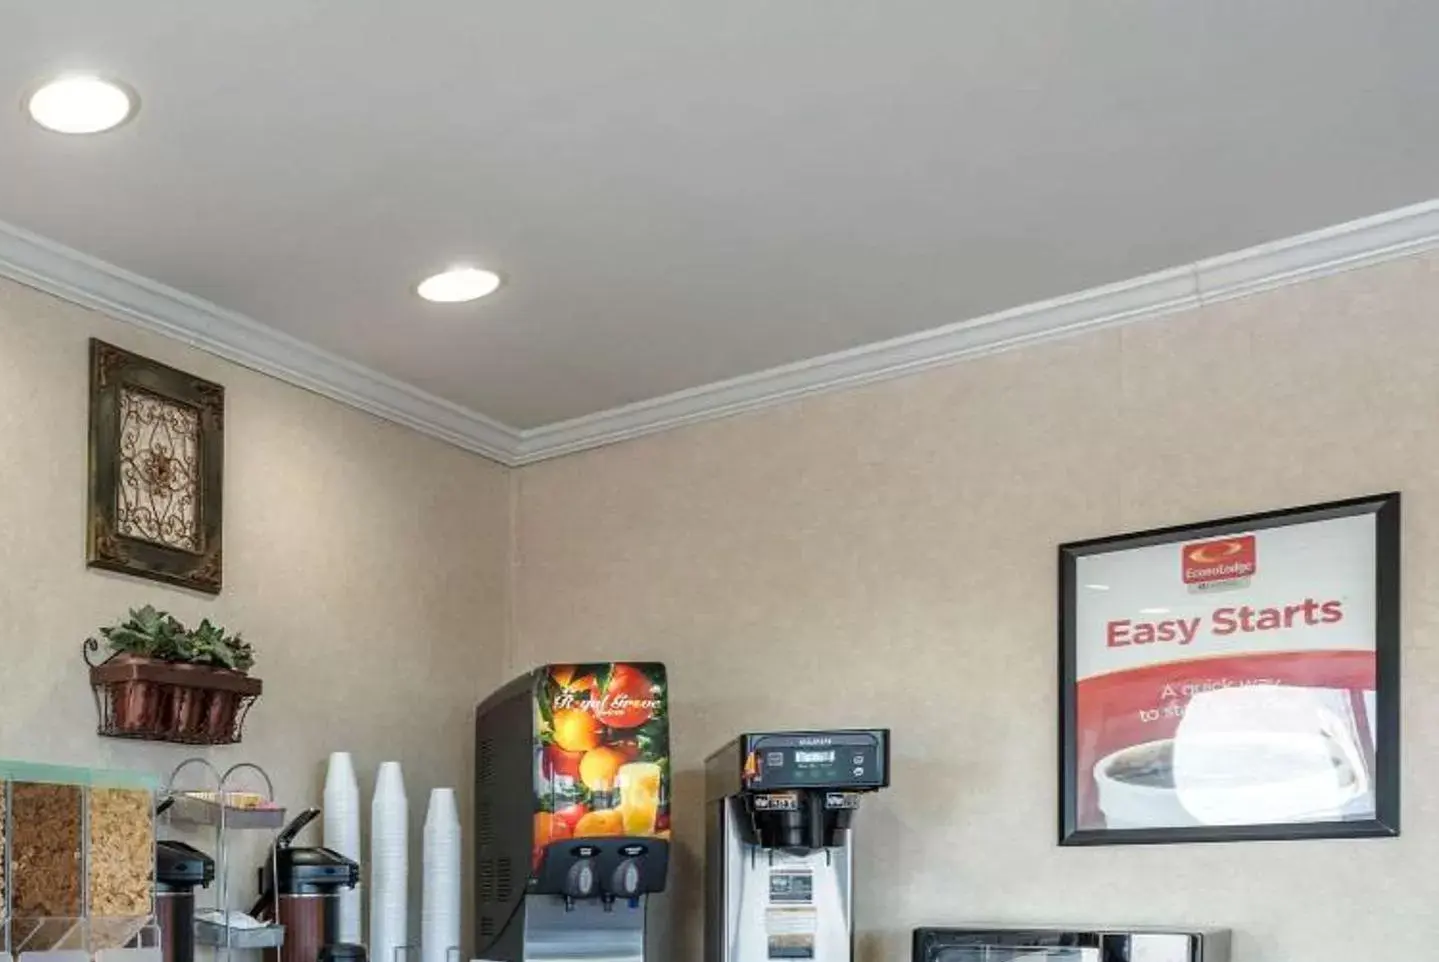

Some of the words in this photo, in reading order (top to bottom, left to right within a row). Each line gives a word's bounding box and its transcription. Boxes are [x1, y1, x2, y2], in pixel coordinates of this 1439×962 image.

[1106, 617, 1201, 647] Easy
[1211, 598, 1343, 635] Starts
[1161, 684, 1178, 700] A
[1138, 706, 1160, 723] to
